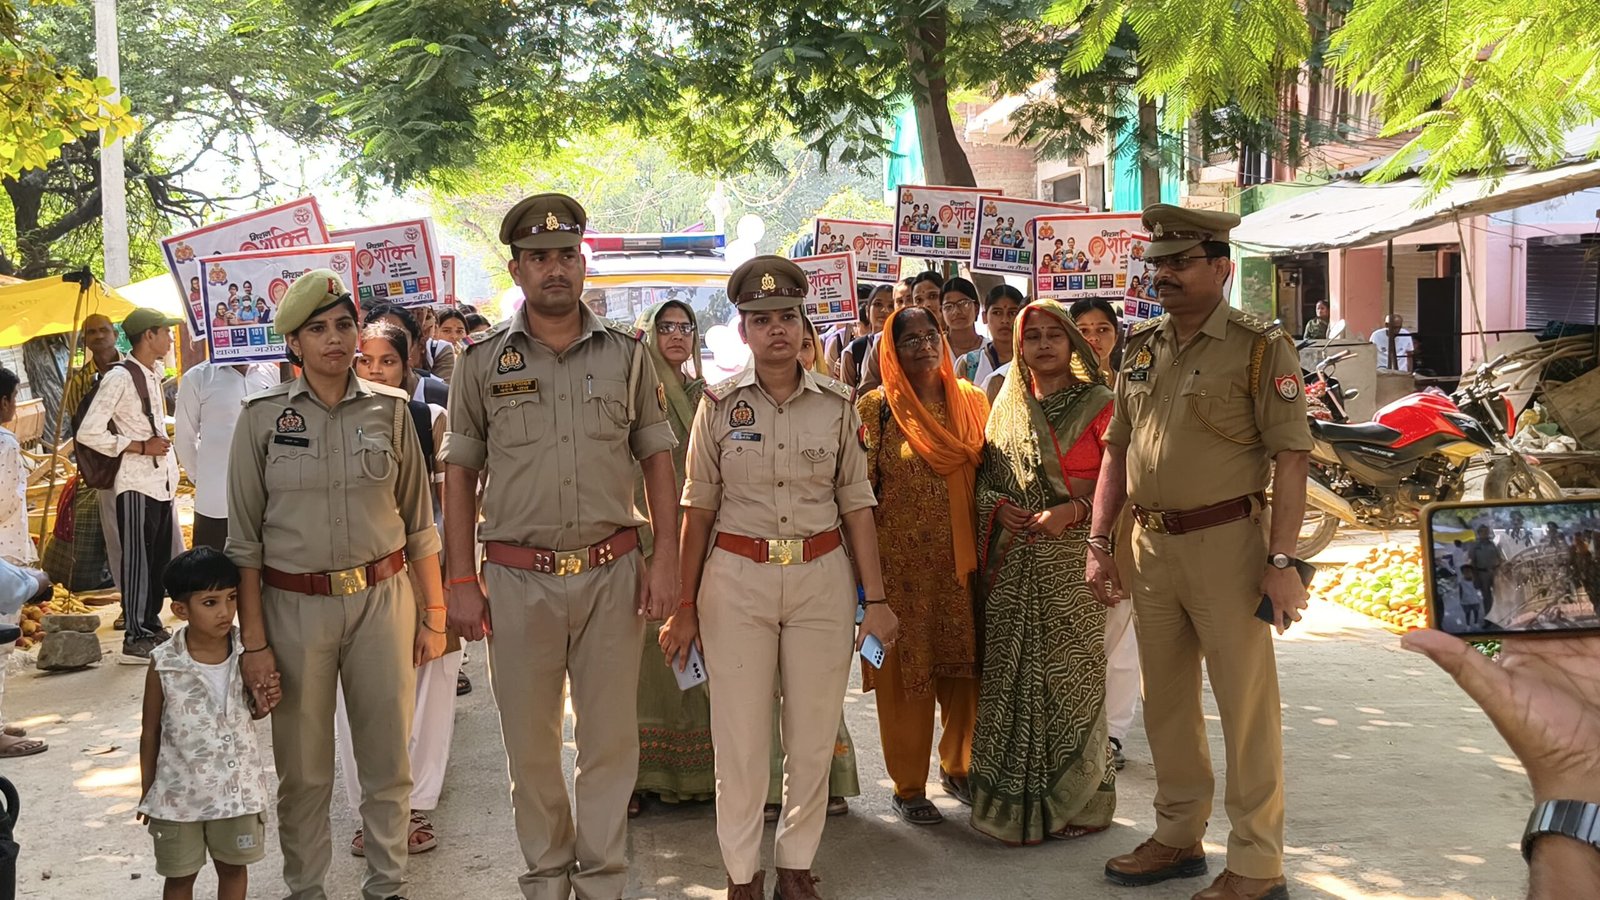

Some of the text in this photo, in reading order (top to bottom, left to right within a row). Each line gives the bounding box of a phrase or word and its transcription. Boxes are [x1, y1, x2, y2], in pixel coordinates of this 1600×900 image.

[249, 230, 272, 242] मिशन
[374, 239, 416, 274] शक्ति
[808, 268, 842, 296] शक्ति
[233, 329, 246, 337] 112
